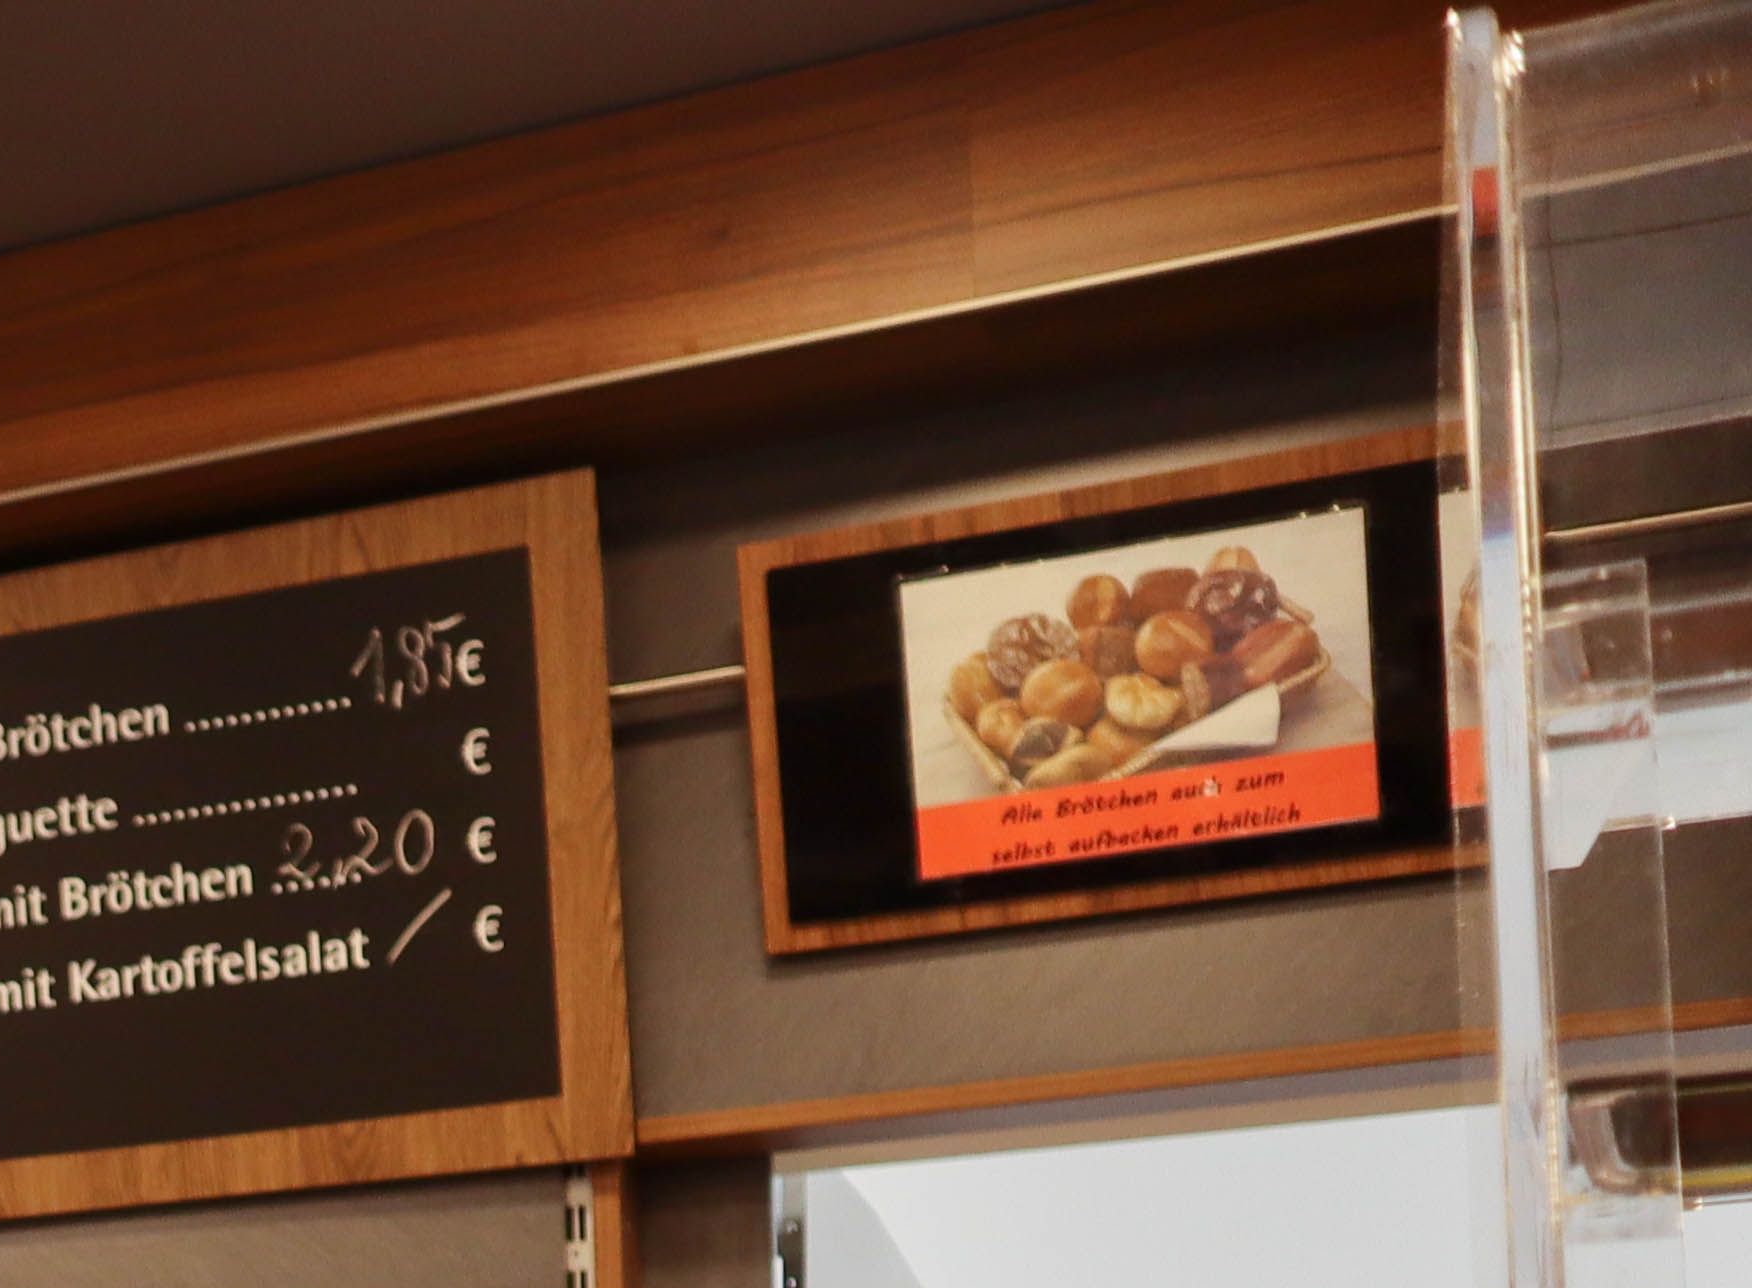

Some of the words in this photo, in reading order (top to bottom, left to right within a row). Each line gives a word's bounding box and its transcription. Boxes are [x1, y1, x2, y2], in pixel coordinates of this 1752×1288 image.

[461, 727, 493, 776] €
[1001, 803, 1044, 827] Alle
[1055, 786, 1159, 821] Brötchen
[1235, 769, 1285, 793] zum
[991, 837, 1056, 866] selbst
[1068, 821, 1180, 855] aufbacken
[1192, 801, 1302, 839] erhältlich
[58, 863, 255, 920] Brötchen
[467, 815, 497, 864] €
[67, 926, 372, 1002] Kartoffelsalat
[474, 904, 505, 952] €
